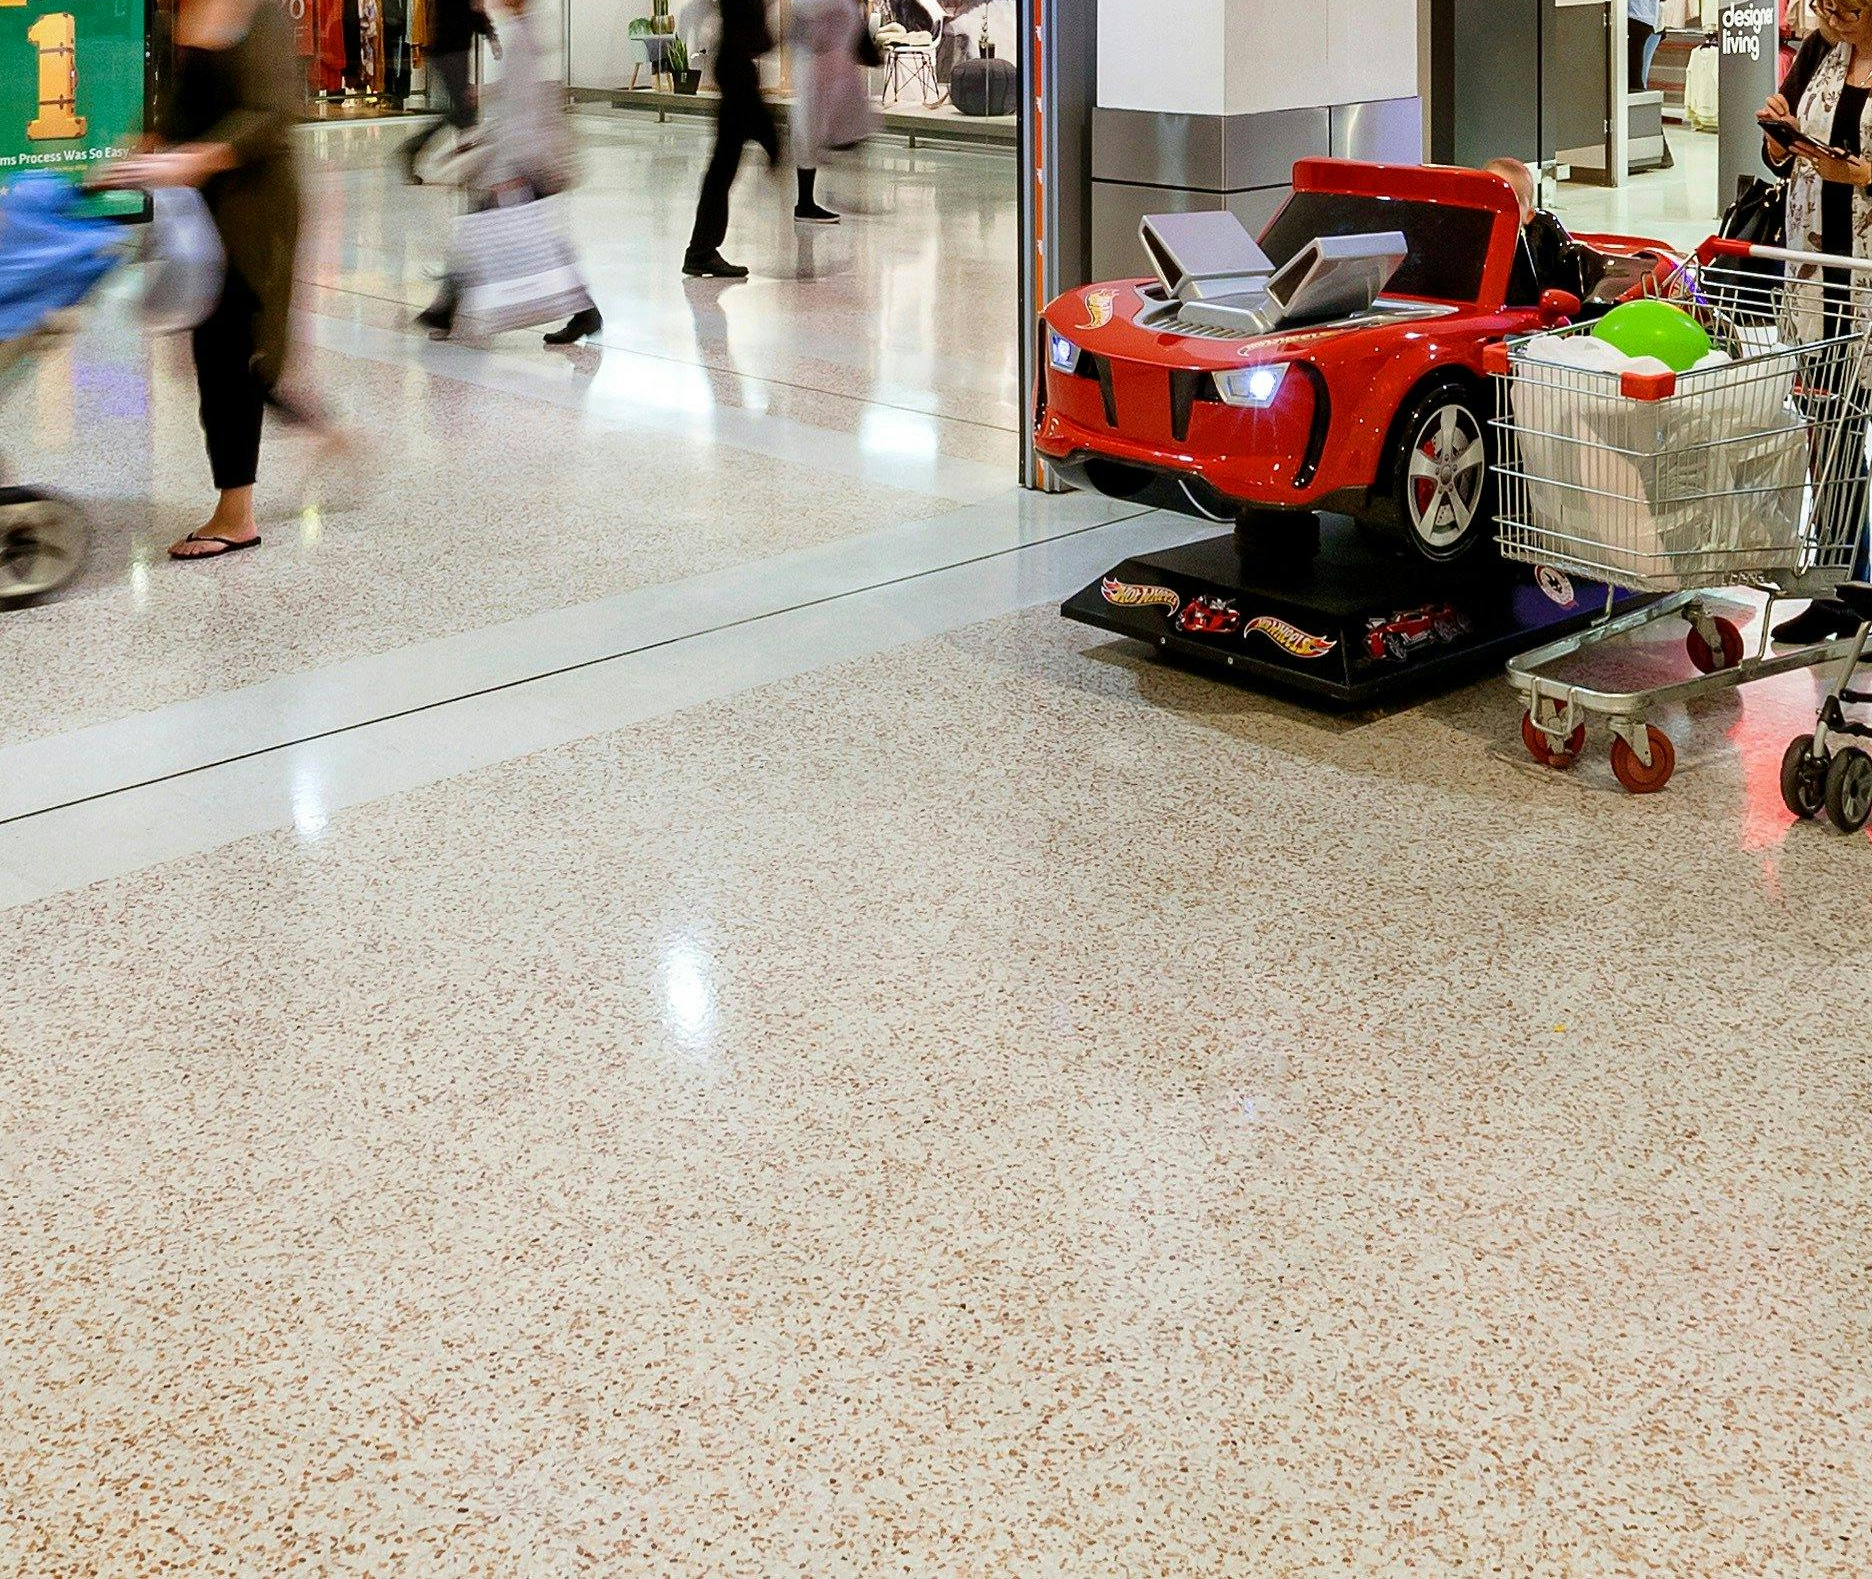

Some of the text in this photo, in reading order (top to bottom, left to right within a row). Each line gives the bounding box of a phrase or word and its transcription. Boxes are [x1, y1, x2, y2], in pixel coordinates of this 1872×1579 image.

[1722, 3, 1774, 35] designer
[1722, 31, 1760, 62] living
[19, 152, 62, 165] Process
[63, 150, 89, 161] Was
[89, 147, 103, 160] So
[1116, 583, 1177, 607] HOT WHEELS
[1257, 618, 1312, 654] HOT WHEELS
